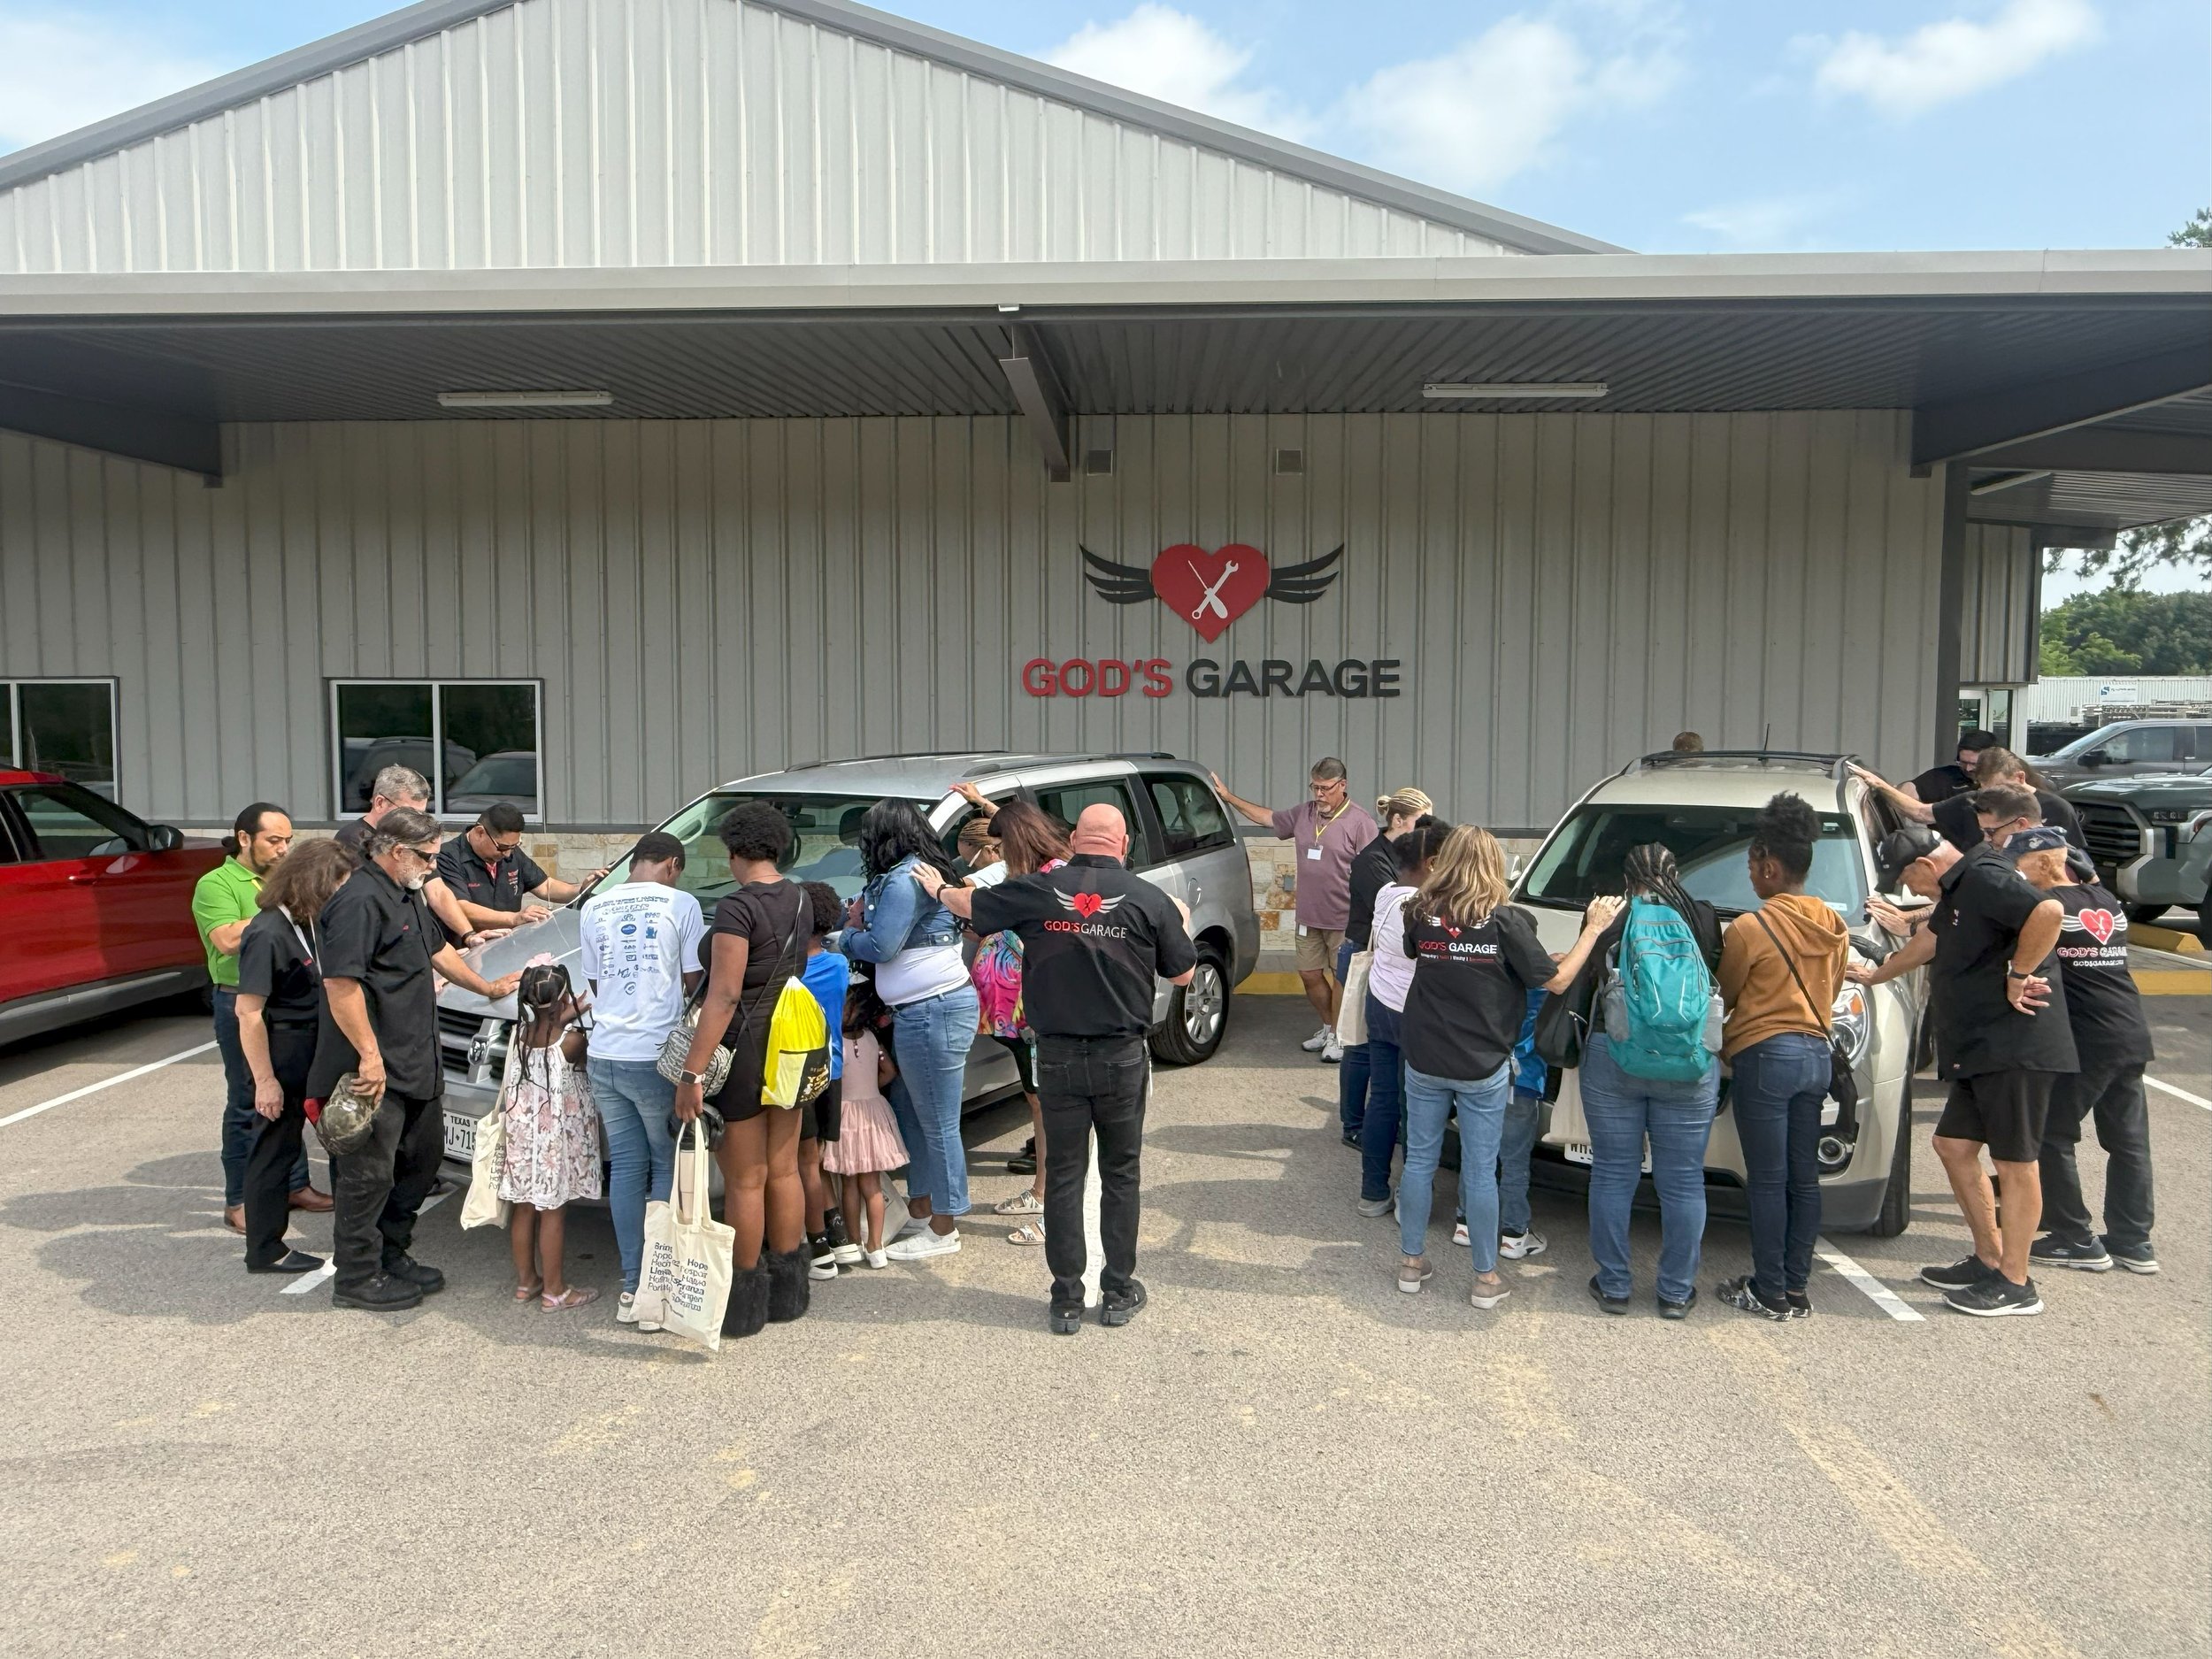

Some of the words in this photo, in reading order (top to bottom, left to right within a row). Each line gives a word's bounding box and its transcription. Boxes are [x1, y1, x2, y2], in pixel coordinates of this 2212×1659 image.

[1022, 657, 1173, 697] GOD'S
[1186, 658, 1401, 697] GARAGE
[1044, 920, 1080, 933] GOD'S
[1080, 923, 1128, 939] GARAGE
[1448, 942, 1498, 954] GARAGE
[2057, 947, 2099, 958] GOD'S
[450, 1115, 470, 1127] TEXAS
